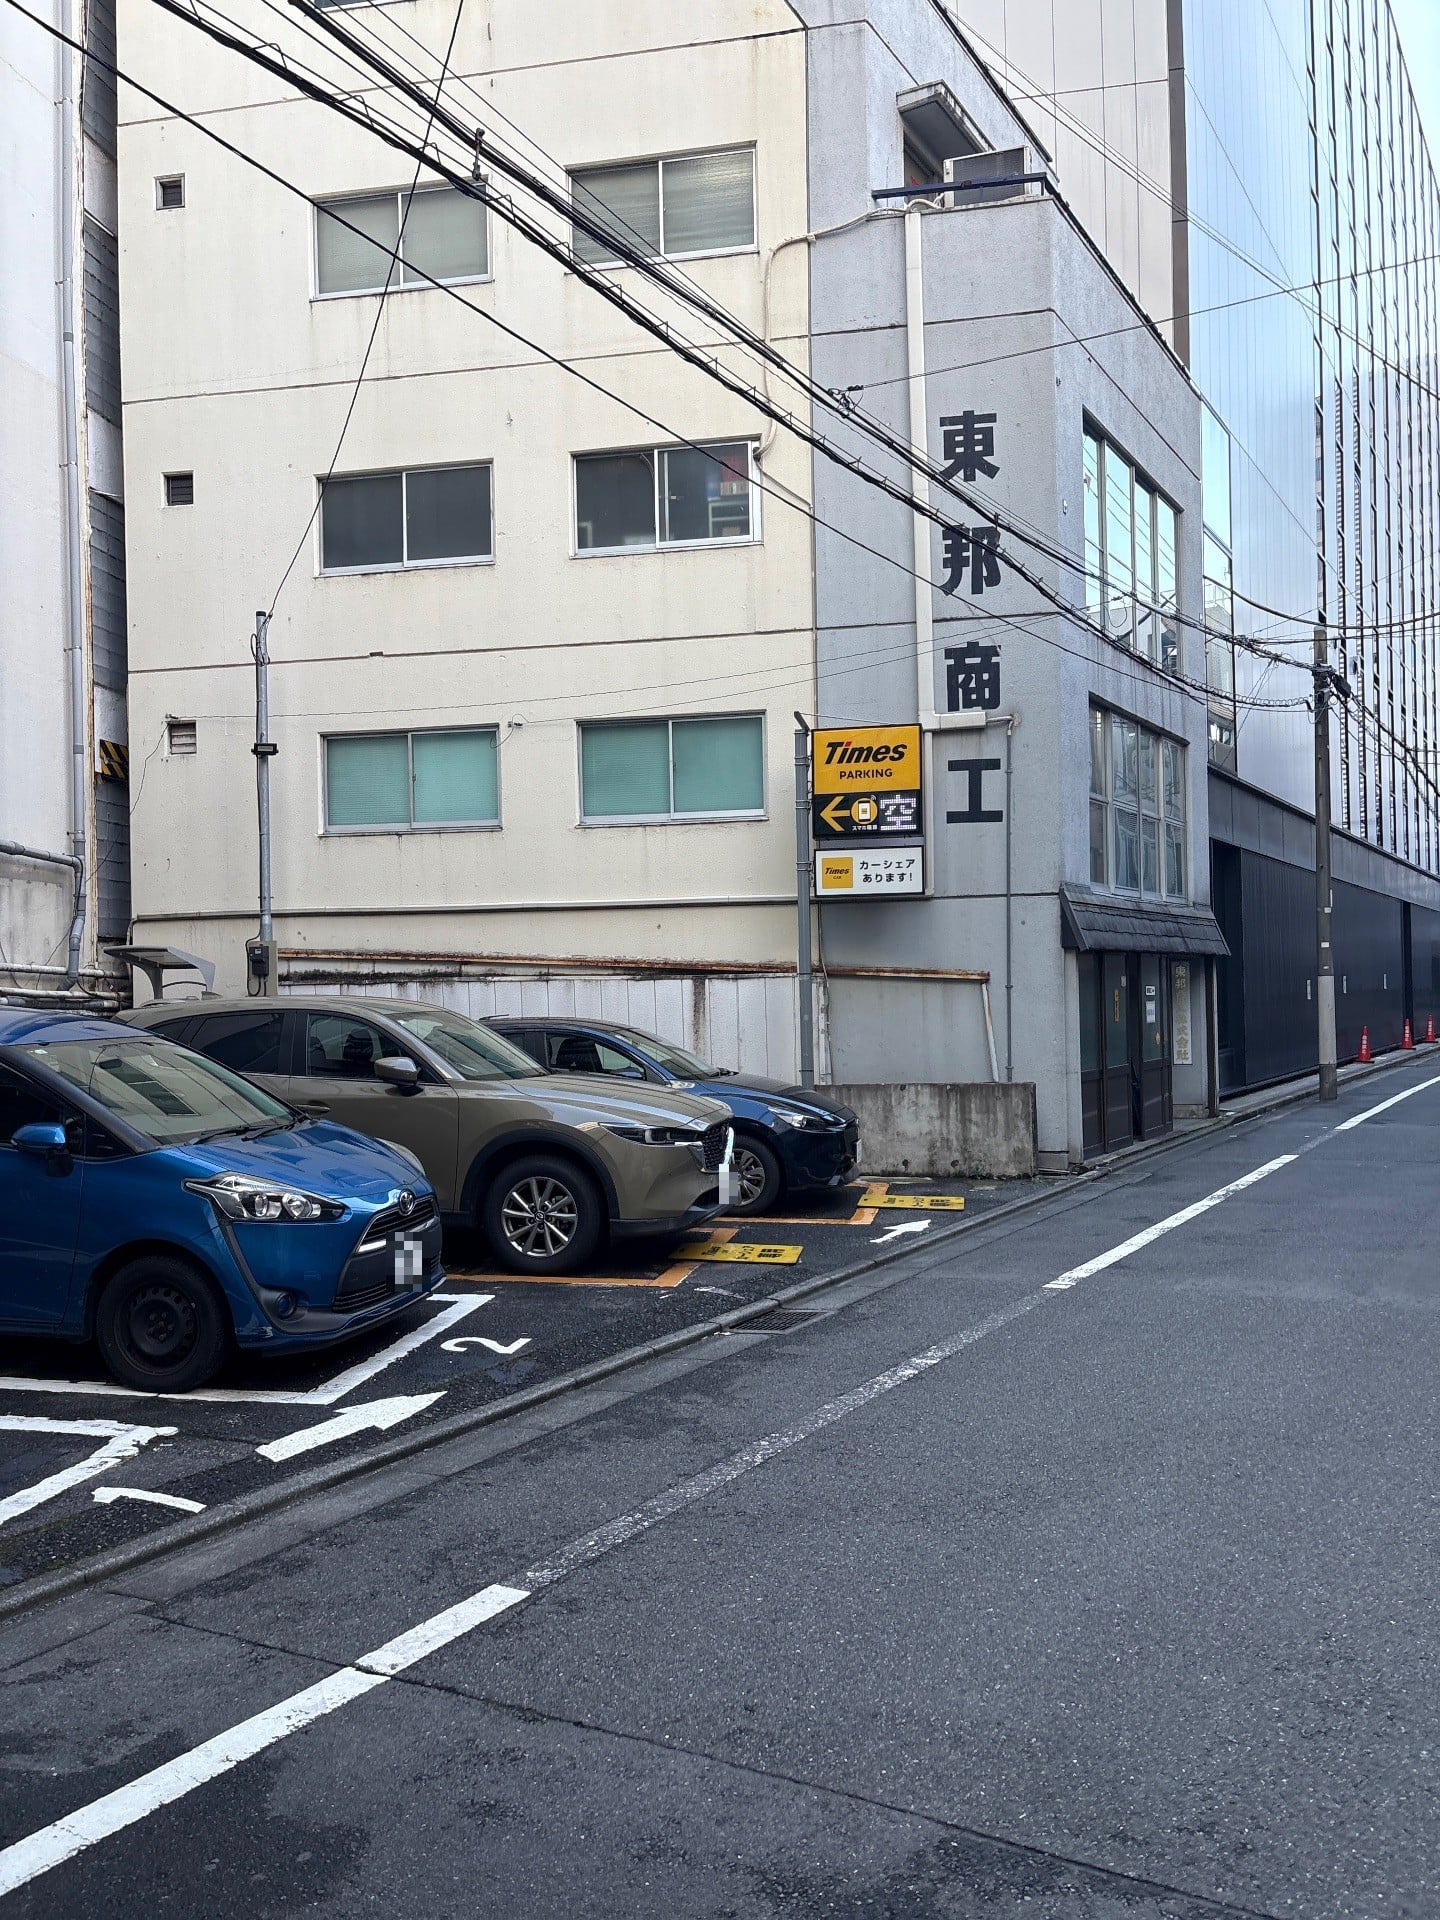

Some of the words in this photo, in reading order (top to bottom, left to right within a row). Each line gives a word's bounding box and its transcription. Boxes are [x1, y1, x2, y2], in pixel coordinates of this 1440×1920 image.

[938, 410, 1003, 824] 東邦商工
[824, 741, 908, 765] Times
[839, 768, 893, 780] PARKING
[880, 794, 917, 831] 空
[824, 867, 850, 875] Times
[859, 858, 916, 870] カーシェア
[862, 872, 913, 883] あります!
[440, 1336, 531, 1355] 2
[92, 1486, 207, 1514] 1
